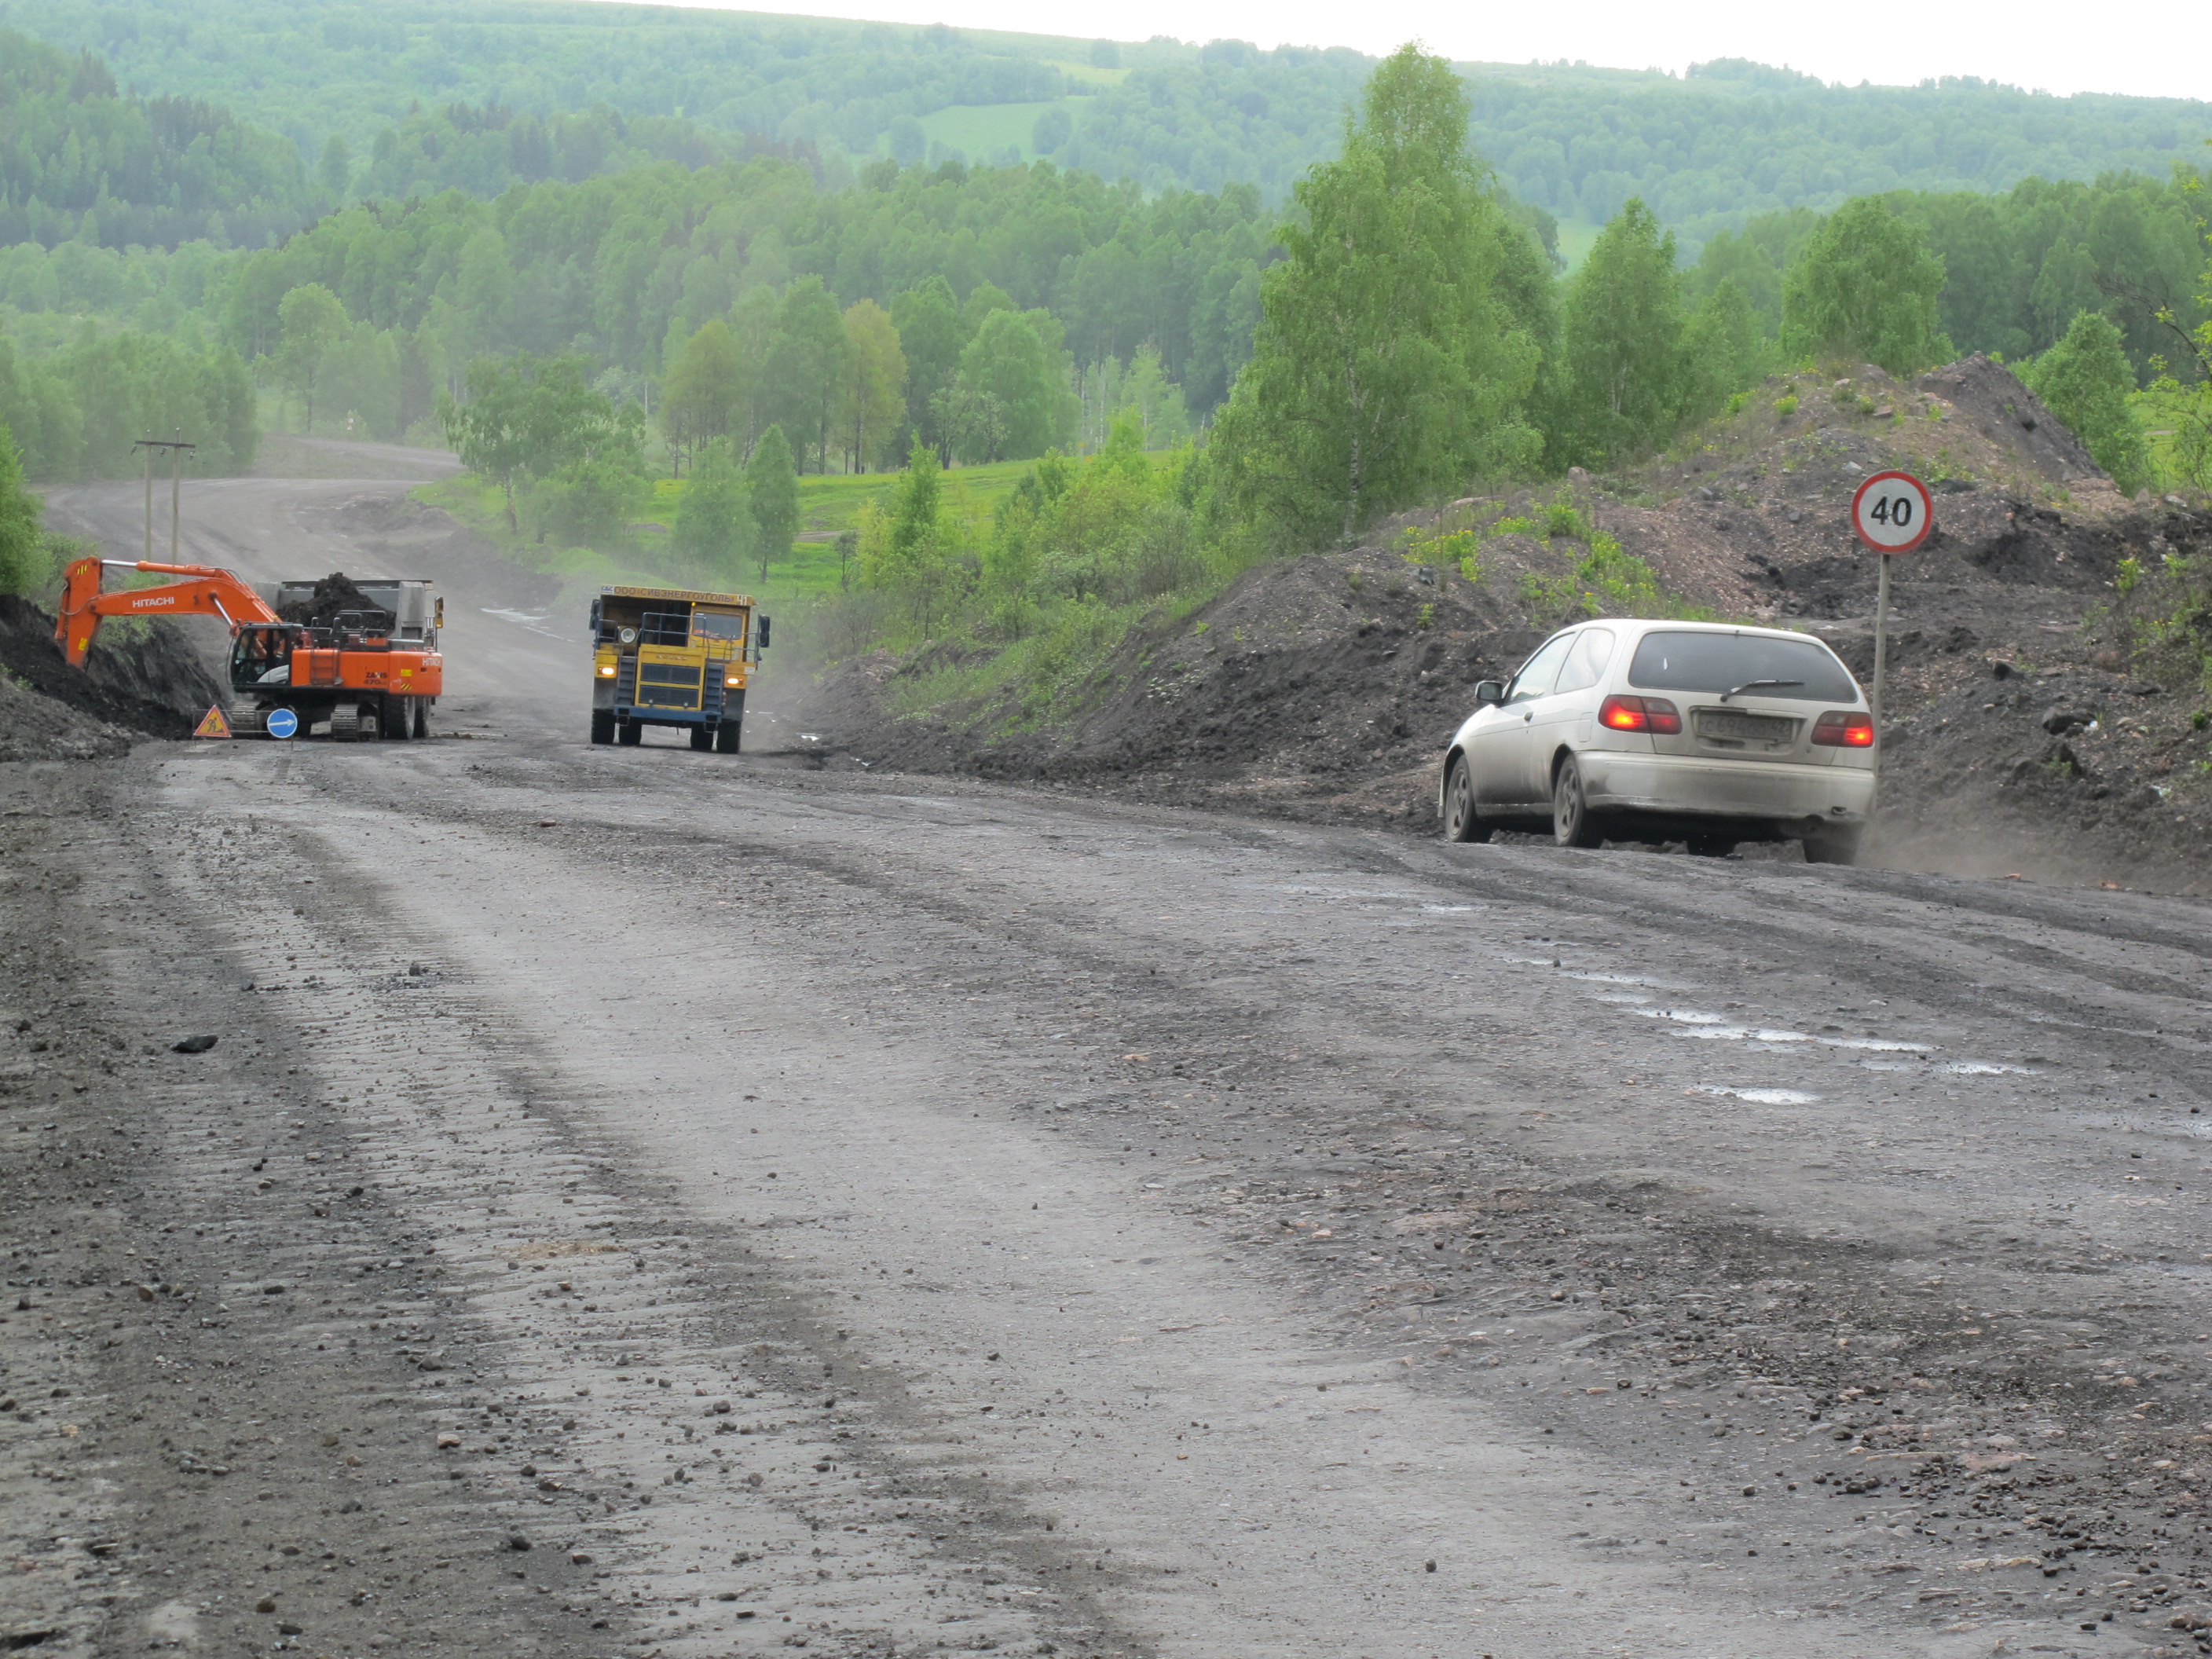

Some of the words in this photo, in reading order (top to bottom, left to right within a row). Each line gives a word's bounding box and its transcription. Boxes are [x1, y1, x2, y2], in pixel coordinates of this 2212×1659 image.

[1871, 496, 1912, 527] 40
[614, 586, 636, 595] ООО
[132, 596, 174, 608] HITACHI
